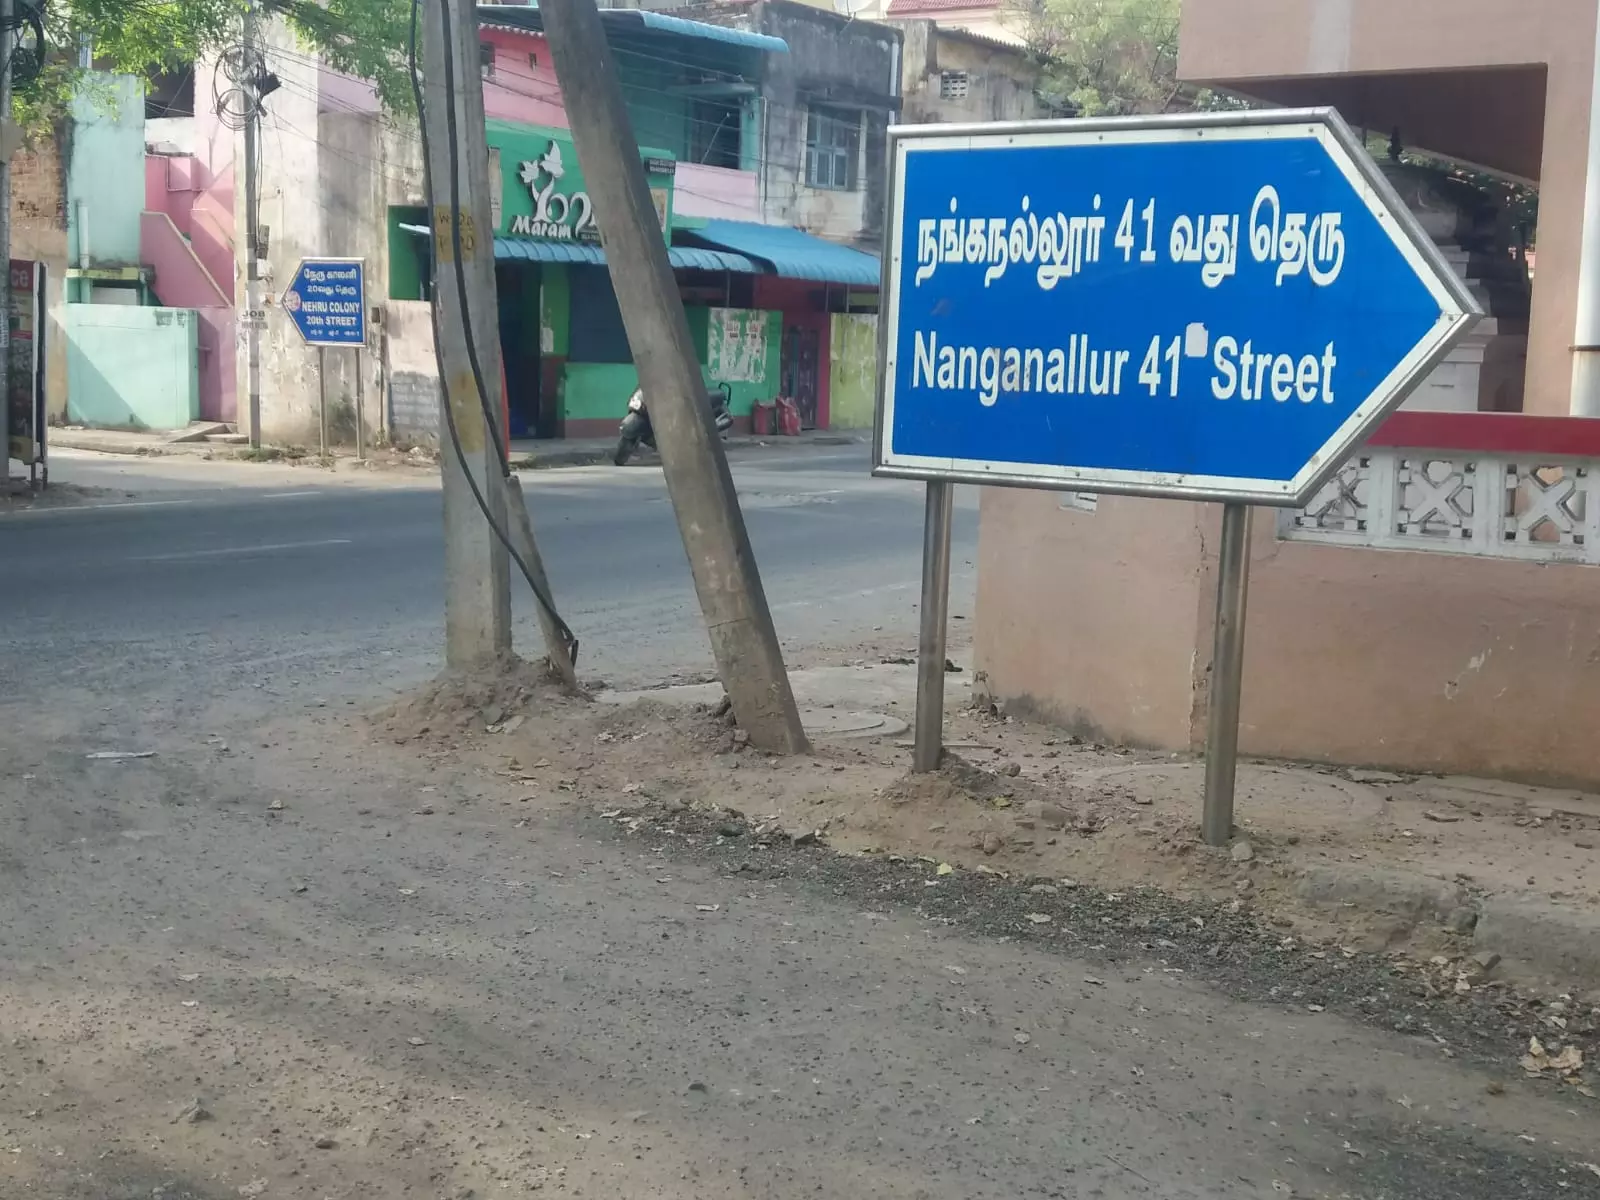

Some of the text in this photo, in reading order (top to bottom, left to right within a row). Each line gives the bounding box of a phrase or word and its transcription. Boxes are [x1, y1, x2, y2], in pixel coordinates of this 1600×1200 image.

[511, 214, 572, 240] Maram
[915, 184, 1345, 290] நங்கநல்லூர் 41 வது தெரு
[242, 310, 265, 318] JOB
[302, 301, 360, 314] NEHRU COLONY
[306, 316, 357, 327] 20th STREET
[912, 331, 1130, 407] Nanganallur
[1211, 335, 1337, 404] Street
